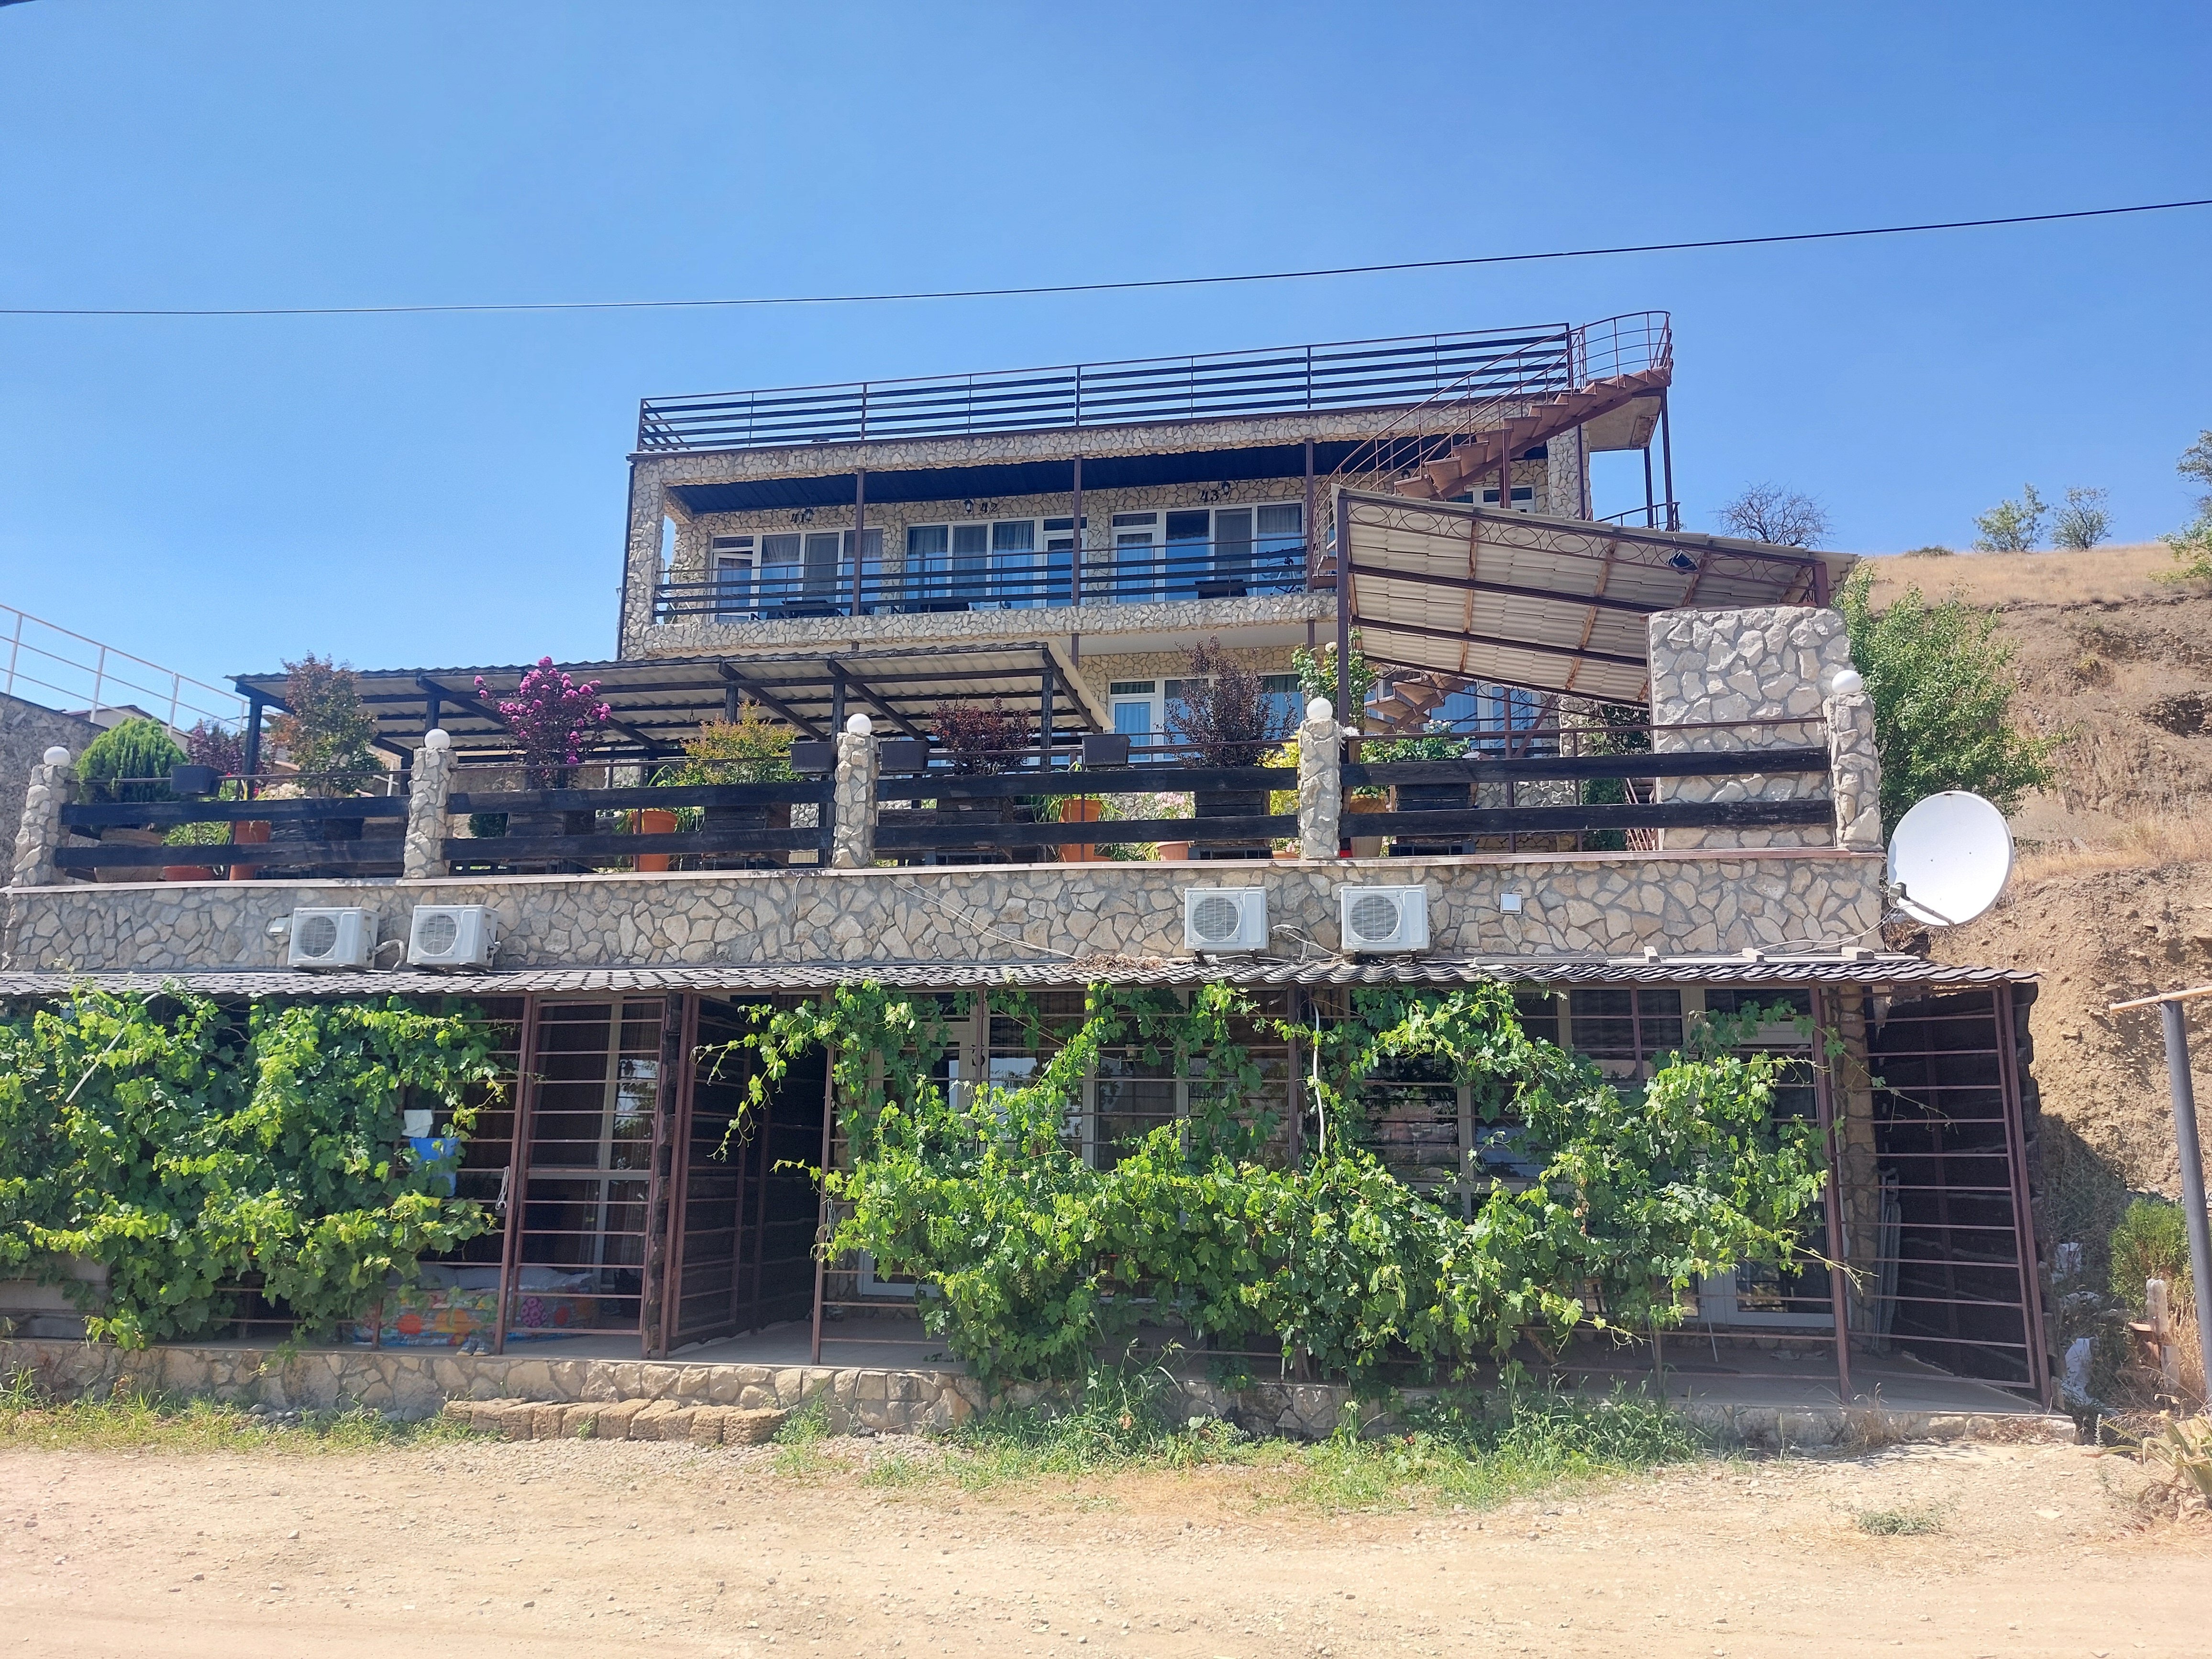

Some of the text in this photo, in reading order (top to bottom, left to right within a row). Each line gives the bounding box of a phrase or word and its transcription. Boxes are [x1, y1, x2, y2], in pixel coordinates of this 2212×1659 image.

[1200, 490, 1219, 502] 43
[980, 502, 997, 513] 42
[790, 513, 805, 523] 41
